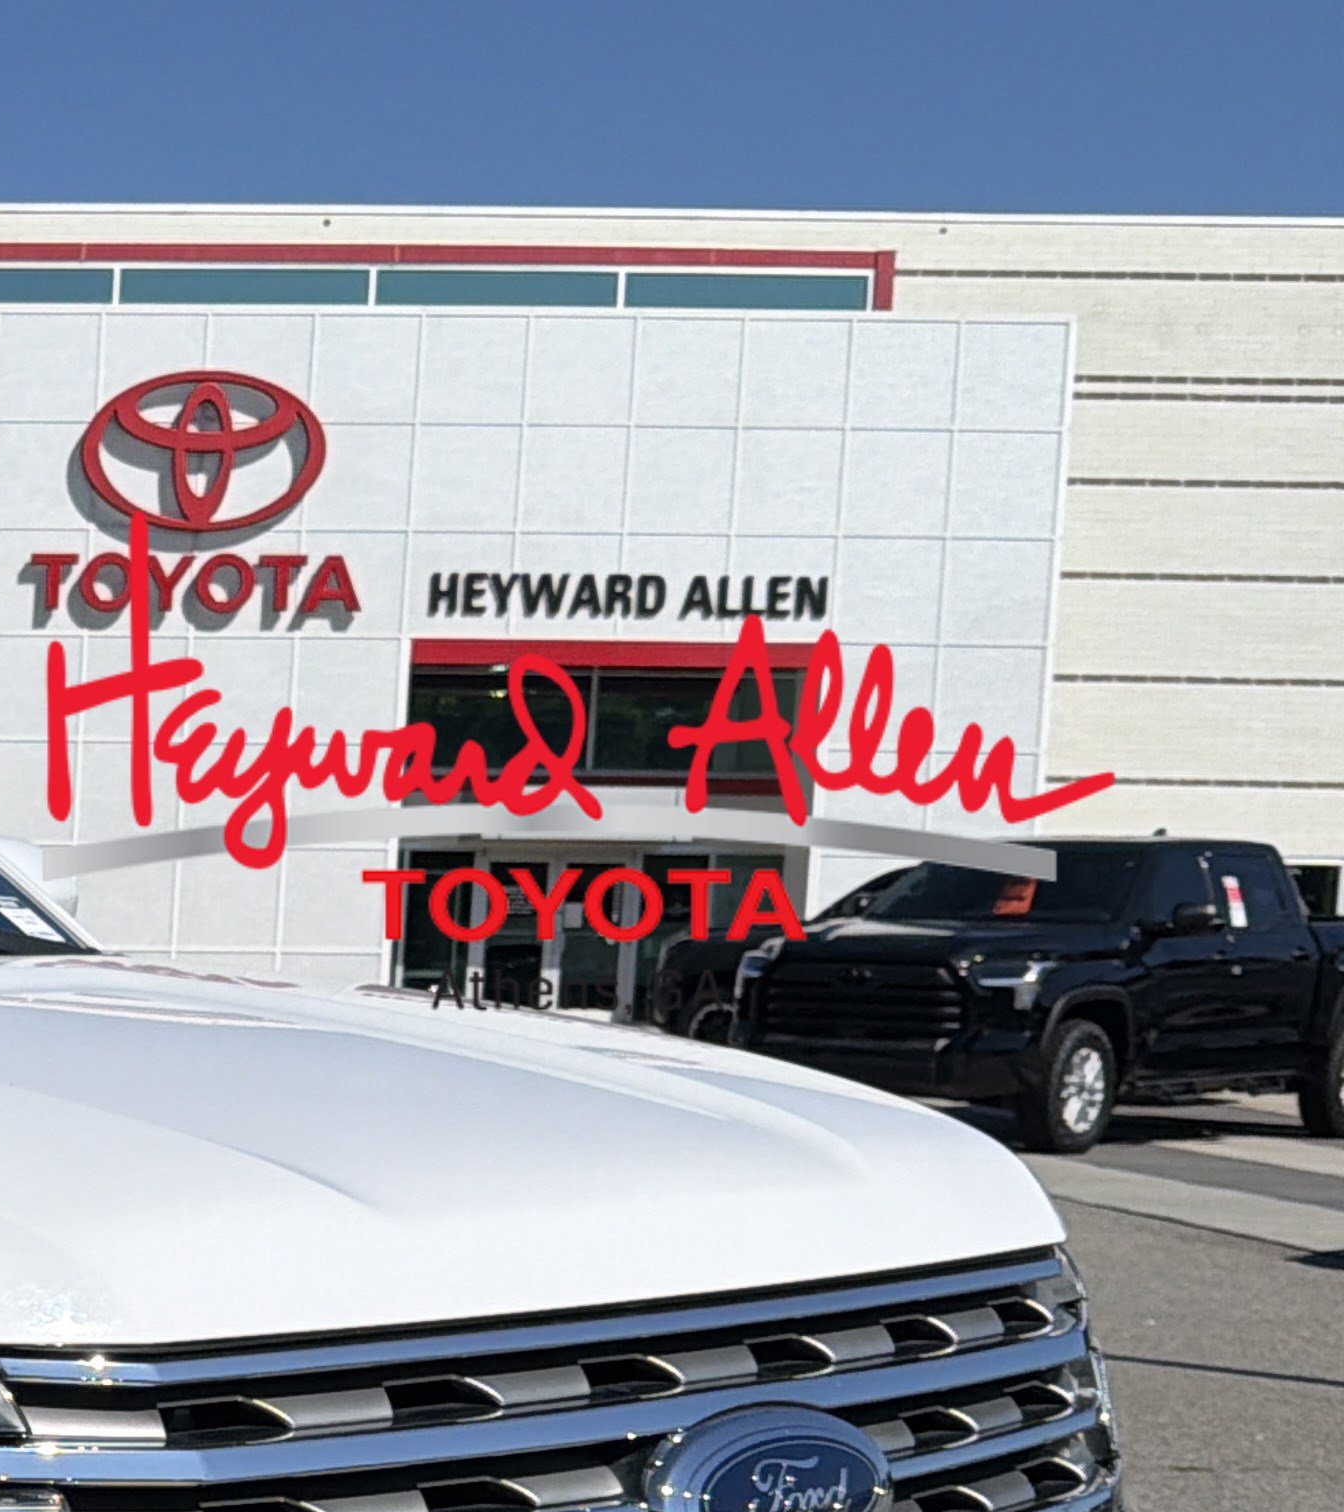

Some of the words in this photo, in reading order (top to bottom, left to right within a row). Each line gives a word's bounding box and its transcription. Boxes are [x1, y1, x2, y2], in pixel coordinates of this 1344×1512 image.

[30, 551, 360, 614] TOYOTA
[427, 572, 667, 618] HEYWARD
[679, 574, 829, 620] ALLEN
